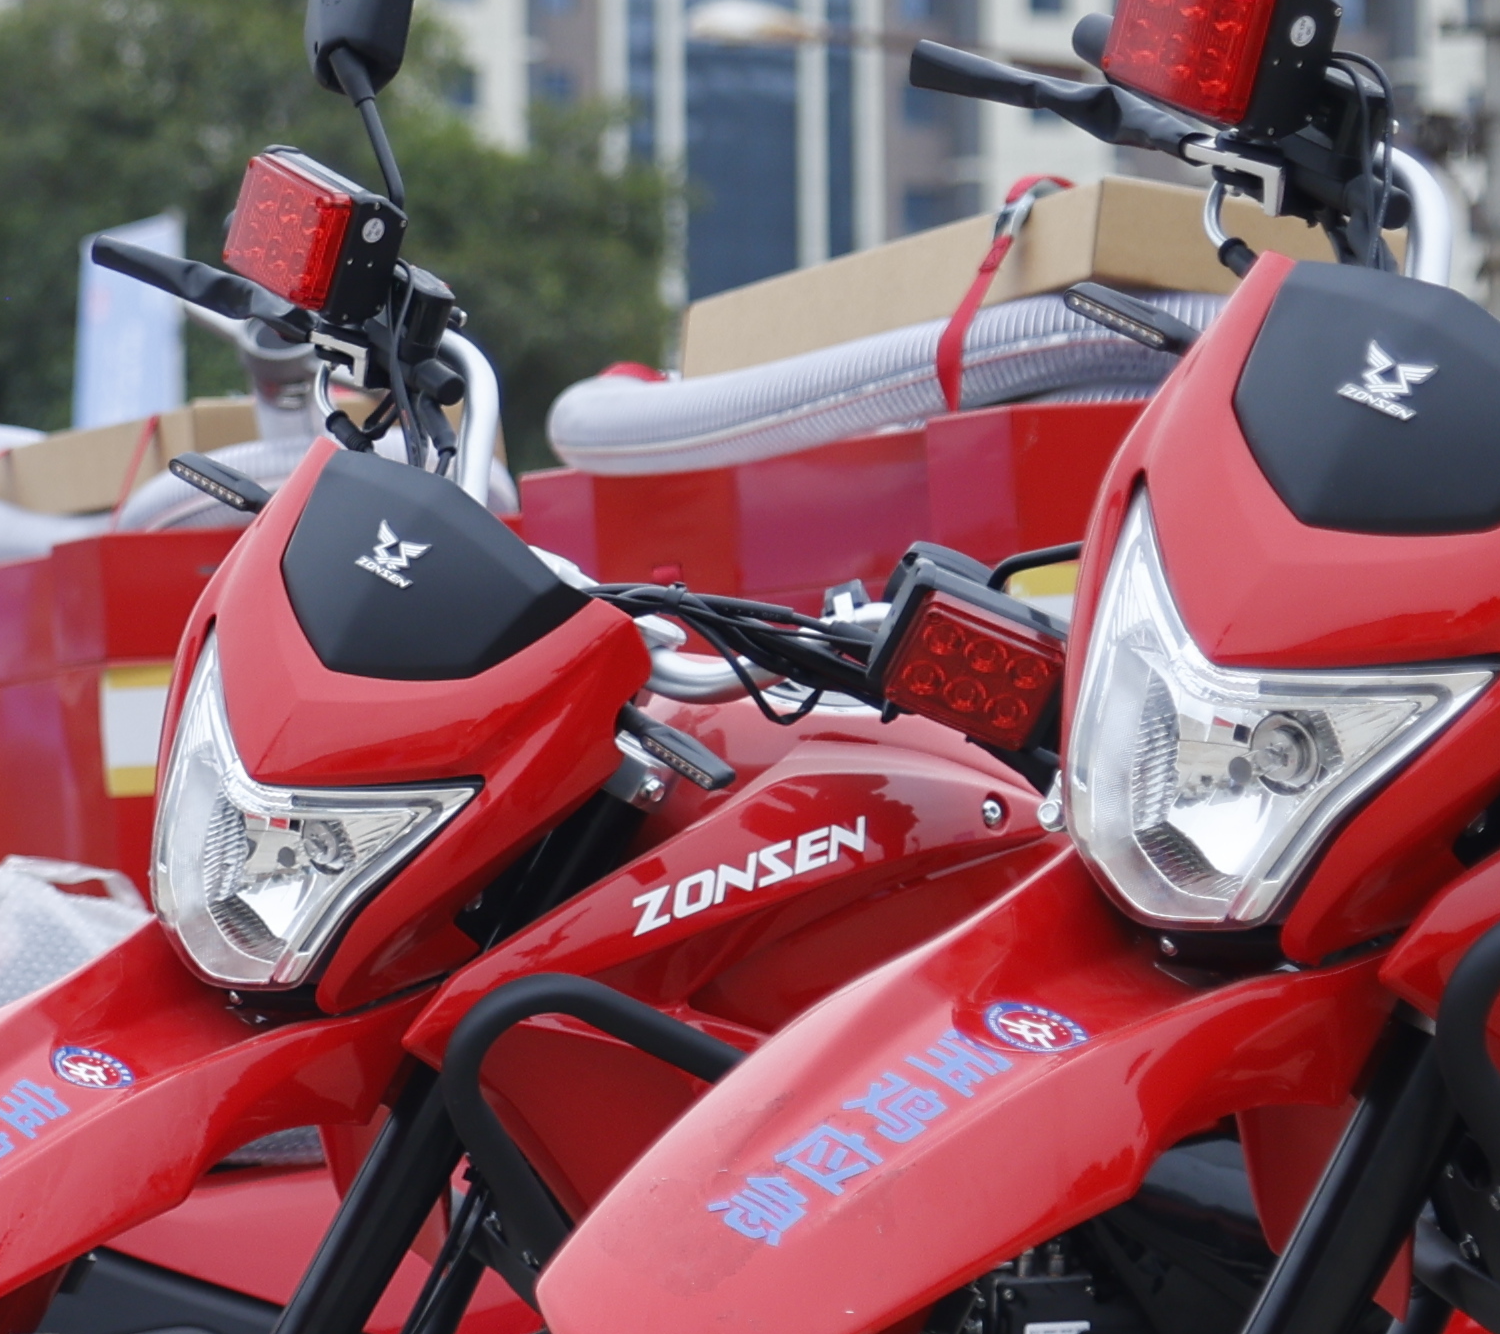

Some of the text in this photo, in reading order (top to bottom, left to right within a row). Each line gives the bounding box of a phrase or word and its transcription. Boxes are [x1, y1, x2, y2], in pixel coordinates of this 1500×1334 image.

[1338, 384, 1416, 420] ZONSEN
[355, 555, 413, 589] ZONSEN
[632, 816, 866, 937] ZONSEN
[707, 1028, 1014, 1246] 宝鸡应急
